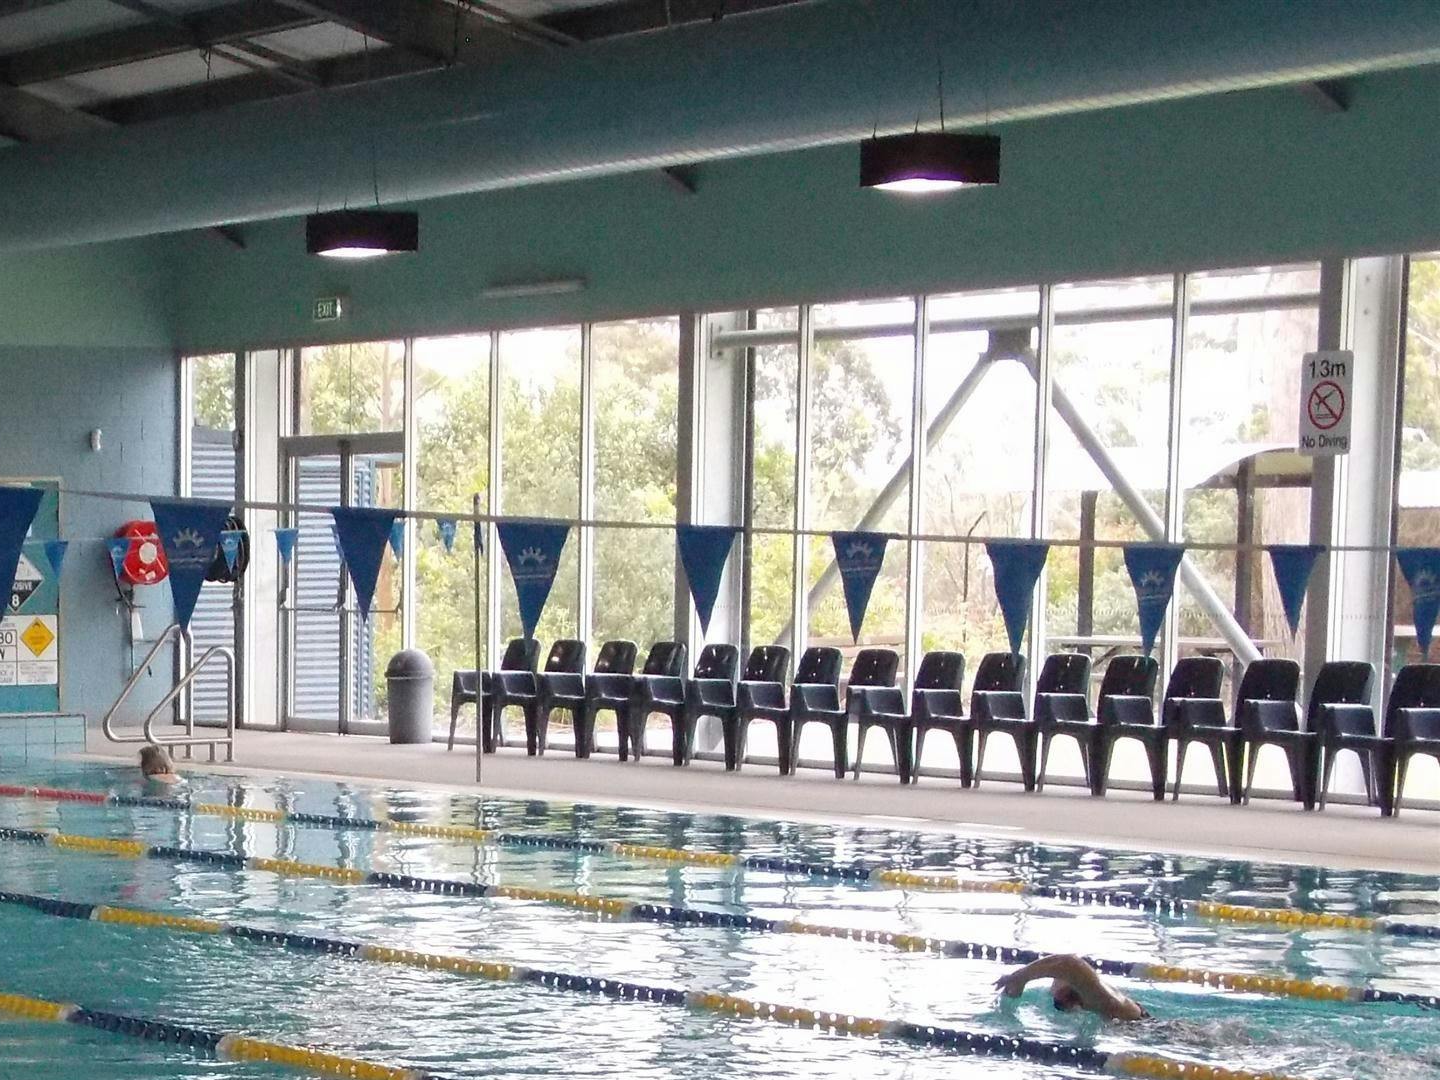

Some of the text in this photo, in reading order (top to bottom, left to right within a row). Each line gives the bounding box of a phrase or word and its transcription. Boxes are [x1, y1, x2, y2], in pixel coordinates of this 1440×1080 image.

[1302, 435, 1348, 449] No Diving
[12, 594, 20, 607] 8
